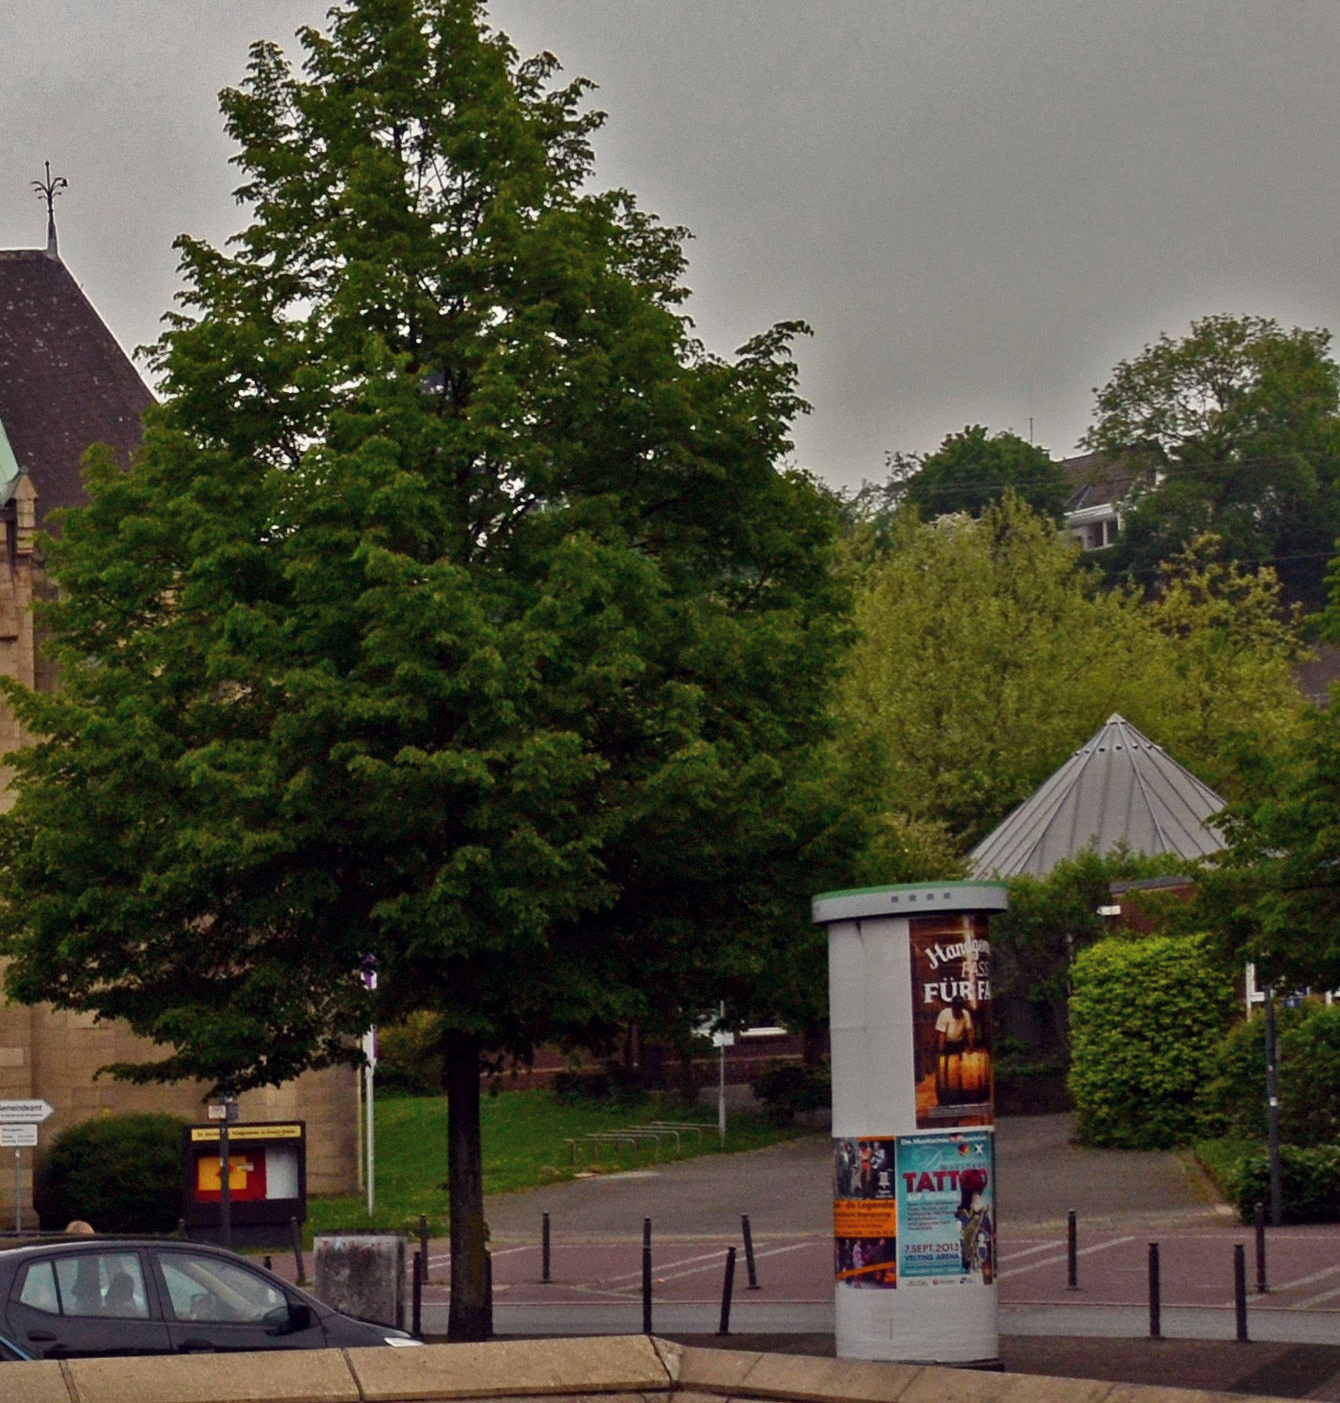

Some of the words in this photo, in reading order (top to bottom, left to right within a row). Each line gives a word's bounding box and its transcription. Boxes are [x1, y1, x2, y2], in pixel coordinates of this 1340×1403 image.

[923, 976, 976, 1004] FÜR
[902, 1169, 988, 1194] TATTO
[904, 1253, 934, 1262] VELTINS
[936, 1252, 960, 1260] ARENA
